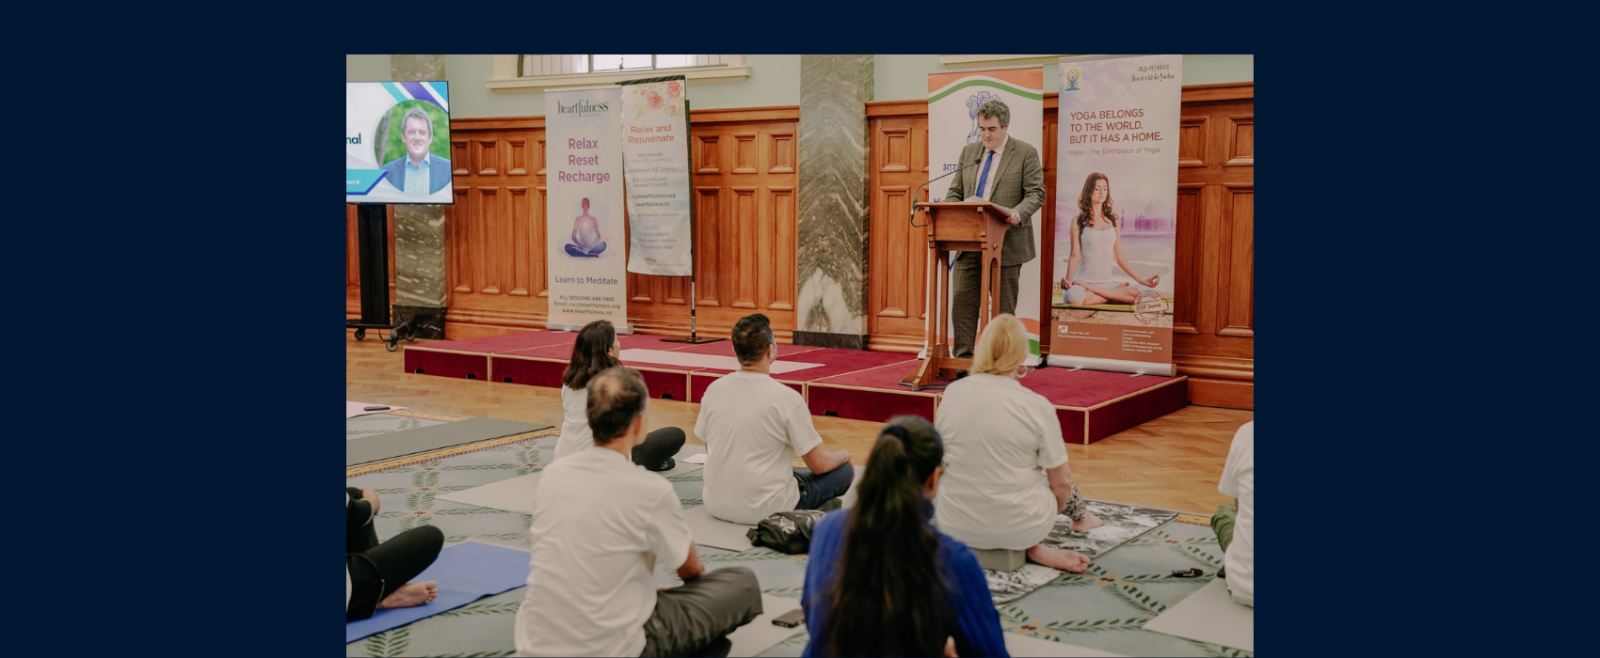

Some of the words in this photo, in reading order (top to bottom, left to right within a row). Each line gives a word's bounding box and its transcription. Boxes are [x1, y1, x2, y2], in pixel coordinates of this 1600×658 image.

[557, 100, 609, 117] heartfulness
[1070, 111, 1097, 121] YOGA
[1099, 108, 1145, 119] BELONGS
[630, 126, 653, 134] Relax
[655, 123, 672, 132] and
[1070, 123, 1083, 132] TO
[1085, 122, 1103, 132] THE
[1106, 120, 1144, 131] WORLD.
[568, 137, 599, 150] Relax
[628, 135, 675, 145] Rejuvenate
[1069, 135, 1088, 144] BUT
[1090, 134, 1098, 143] IT
[1100, 133, 1120, 143] HAS
[1122, 133, 1130, 142] A
[1131, 131, 1163, 142] HOME.
[1102, 147, 1134, 156] Birthplace
[1143, 146, 1160, 155] Yoga
[568, 154, 599, 166] Reset
[943, 163, 959, 171] भार
[558, 170, 611, 184] Recharge
[555, 275, 576, 284] Learn
[576, 276, 585, 284] to
[586, 276, 619, 286] Meditate
[1147, 302, 1161, 310] June
